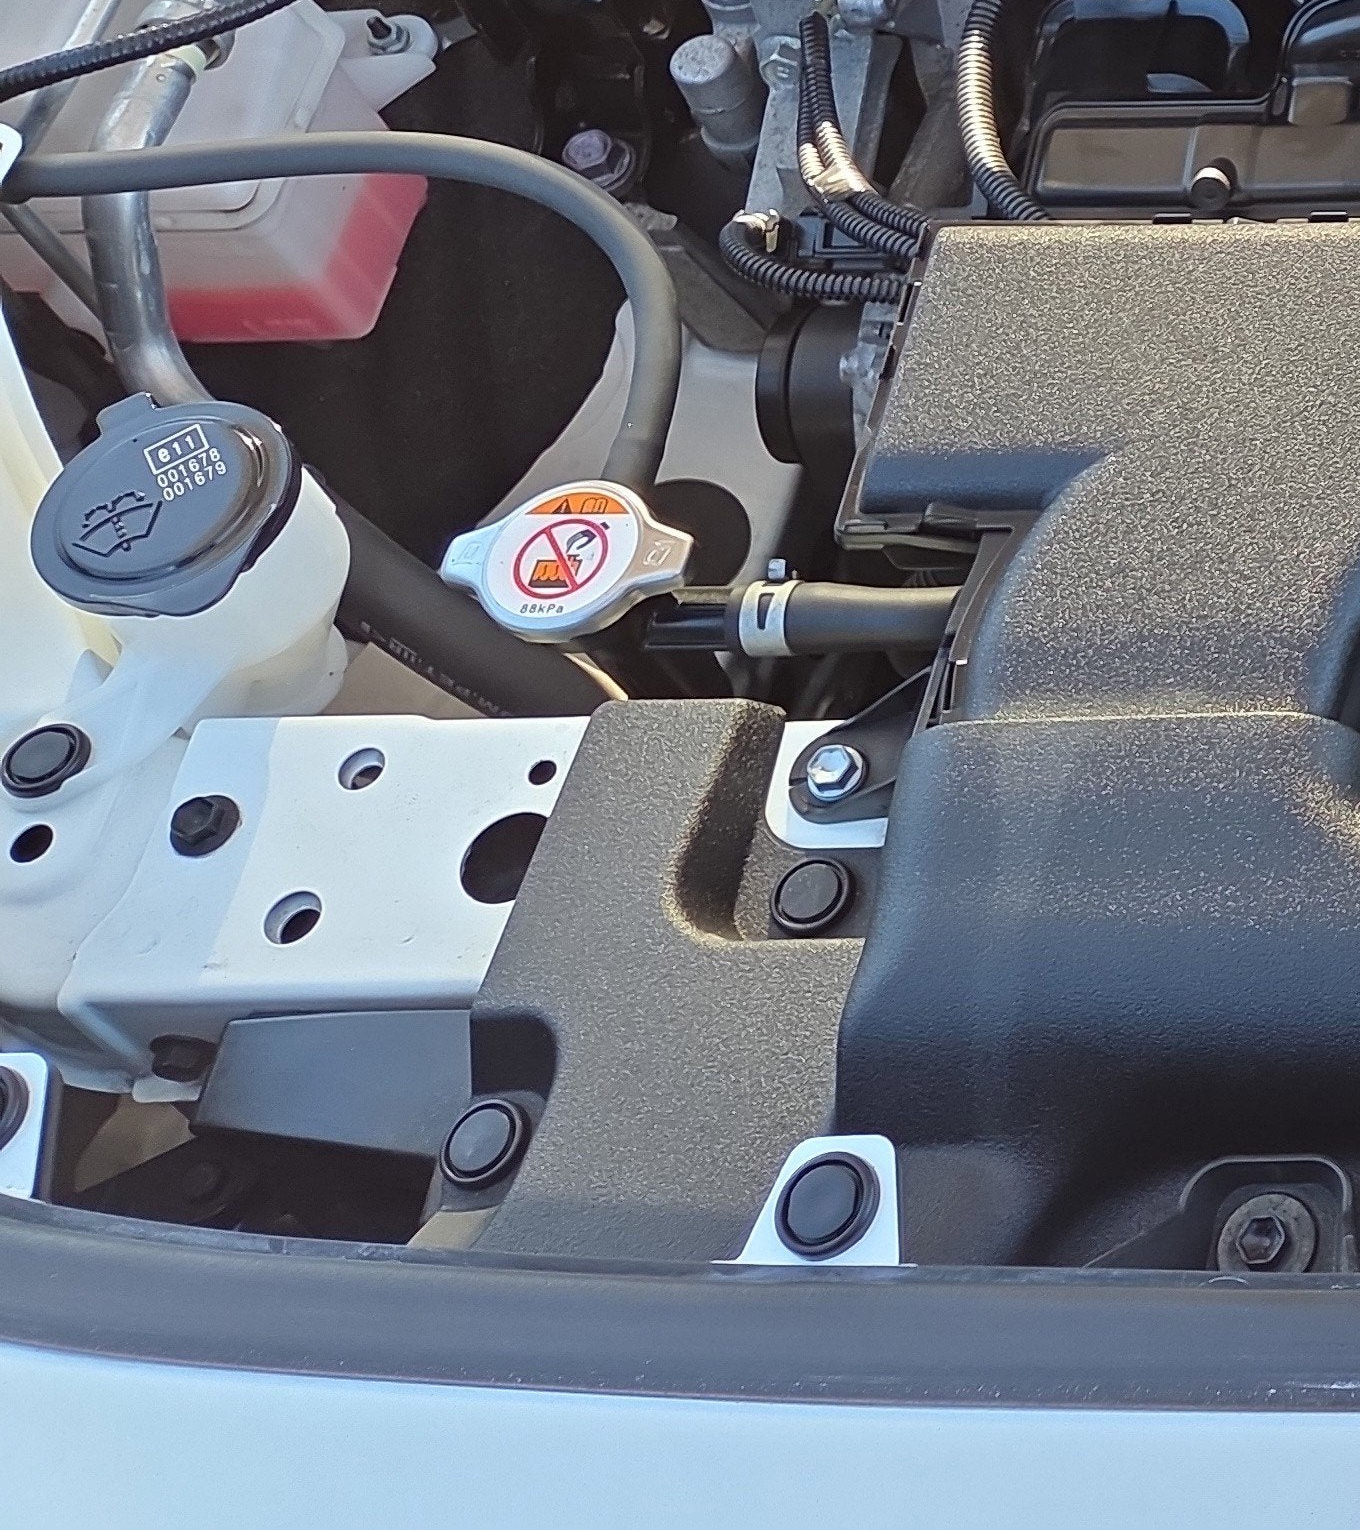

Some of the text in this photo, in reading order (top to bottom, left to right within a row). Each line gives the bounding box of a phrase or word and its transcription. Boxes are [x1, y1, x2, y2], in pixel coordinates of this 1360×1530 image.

[157, 434, 196, 463] e11
[157, 447, 221, 488] 001678
[163, 461, 227, 501] 001679
[519, 603, 564, 614] 88kPa
